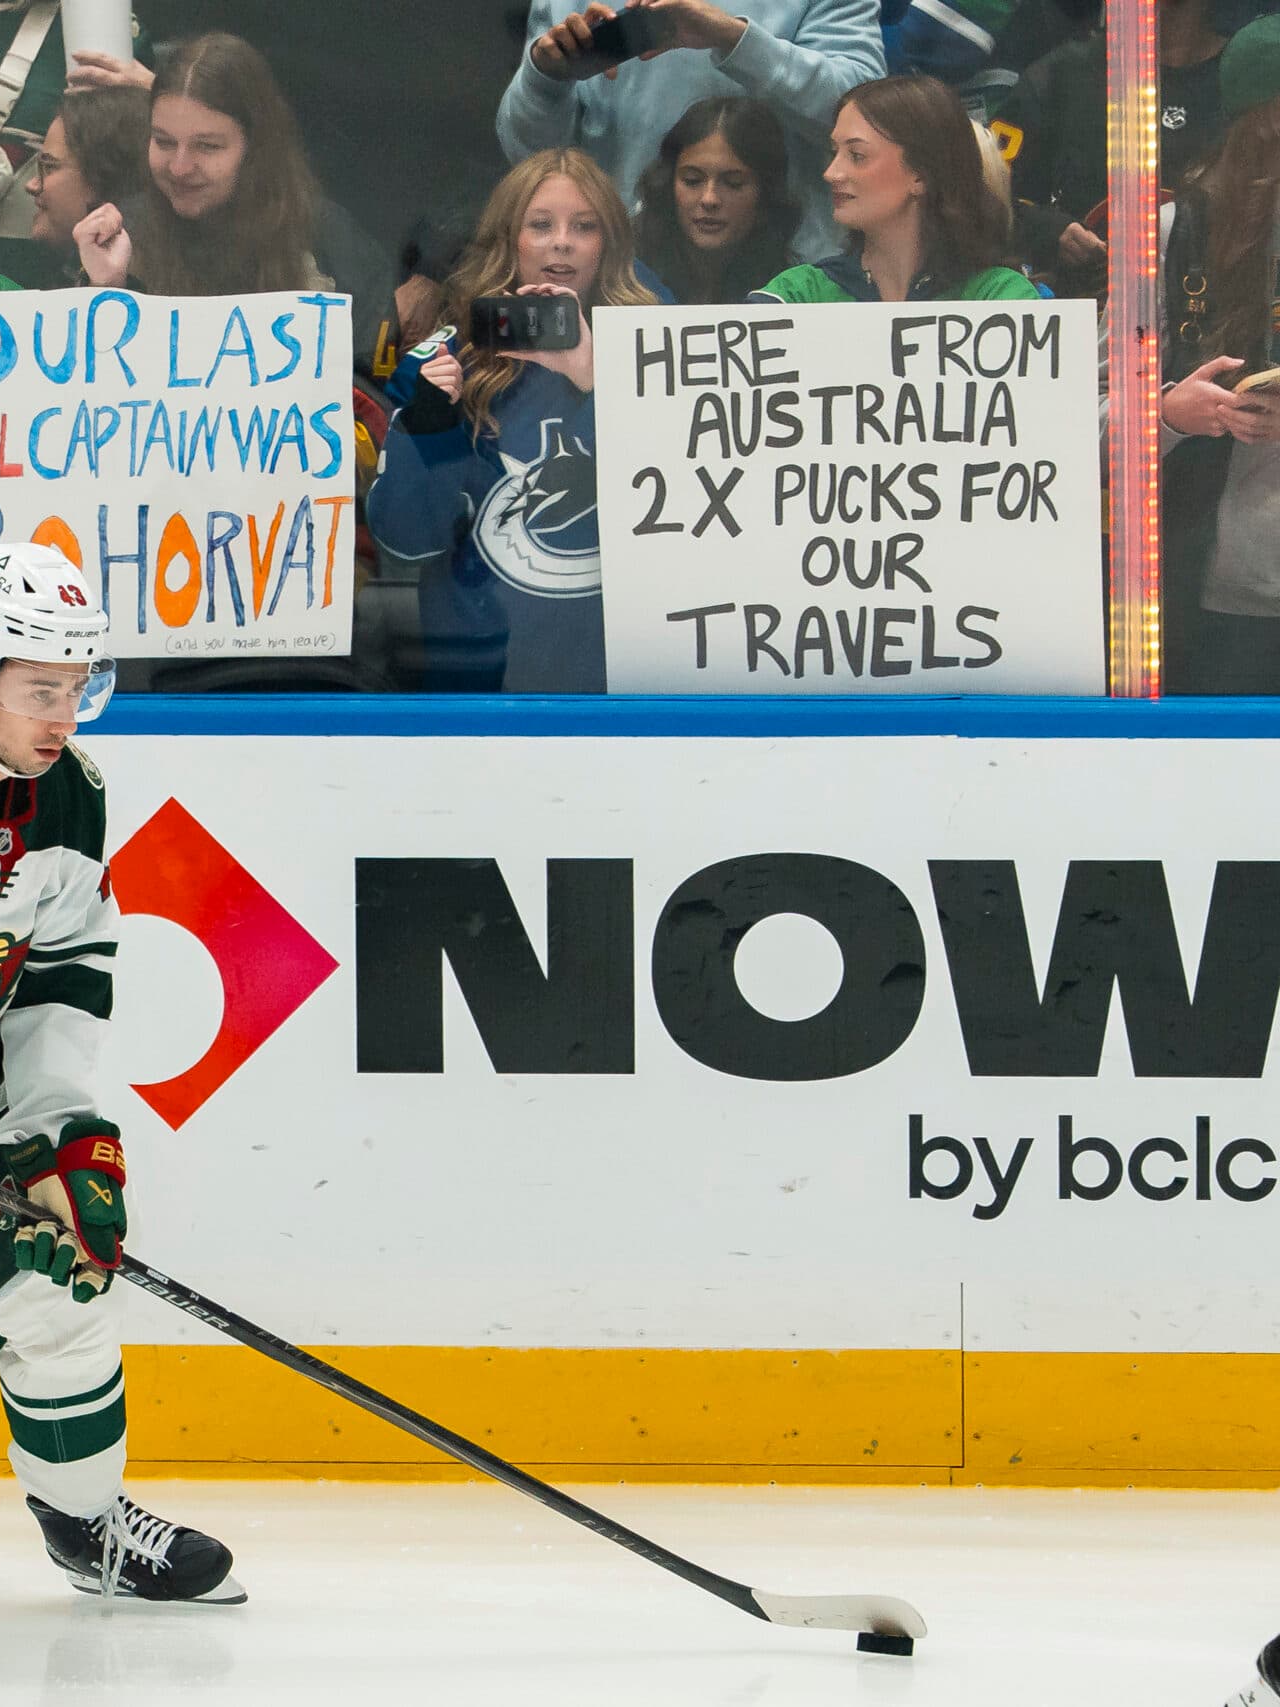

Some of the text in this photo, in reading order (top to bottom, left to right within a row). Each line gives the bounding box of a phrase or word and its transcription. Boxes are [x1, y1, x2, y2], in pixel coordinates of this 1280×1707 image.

[167, 294, 346, 388] LAST
[635, 313, 1061, 397] HERE FROM
[28, 400, 222, 479] CAPTAIN
[228, 402, 343, 479] WAS
[686, 381, 1017, 459] AUSTRALIA
[632, 460, 1059, 538] 2 X PUCKS FOR
[58, 584, 88, 607] 43
[99, 495, 353, 635] HORVAT
[802, 533, 932, 593] OUR
[64, 630, 100, 638] BAUER
[231, 637, 261, 648] made
[666, 603, 1003, 679] TRAVELS
[354, 851, 1280, 1082] NOW
[908, 1113, 1278, 1221] by bclc
[125, 1271, 230, 1330] BAUER
[90, 1561, 137, 1589] BER
